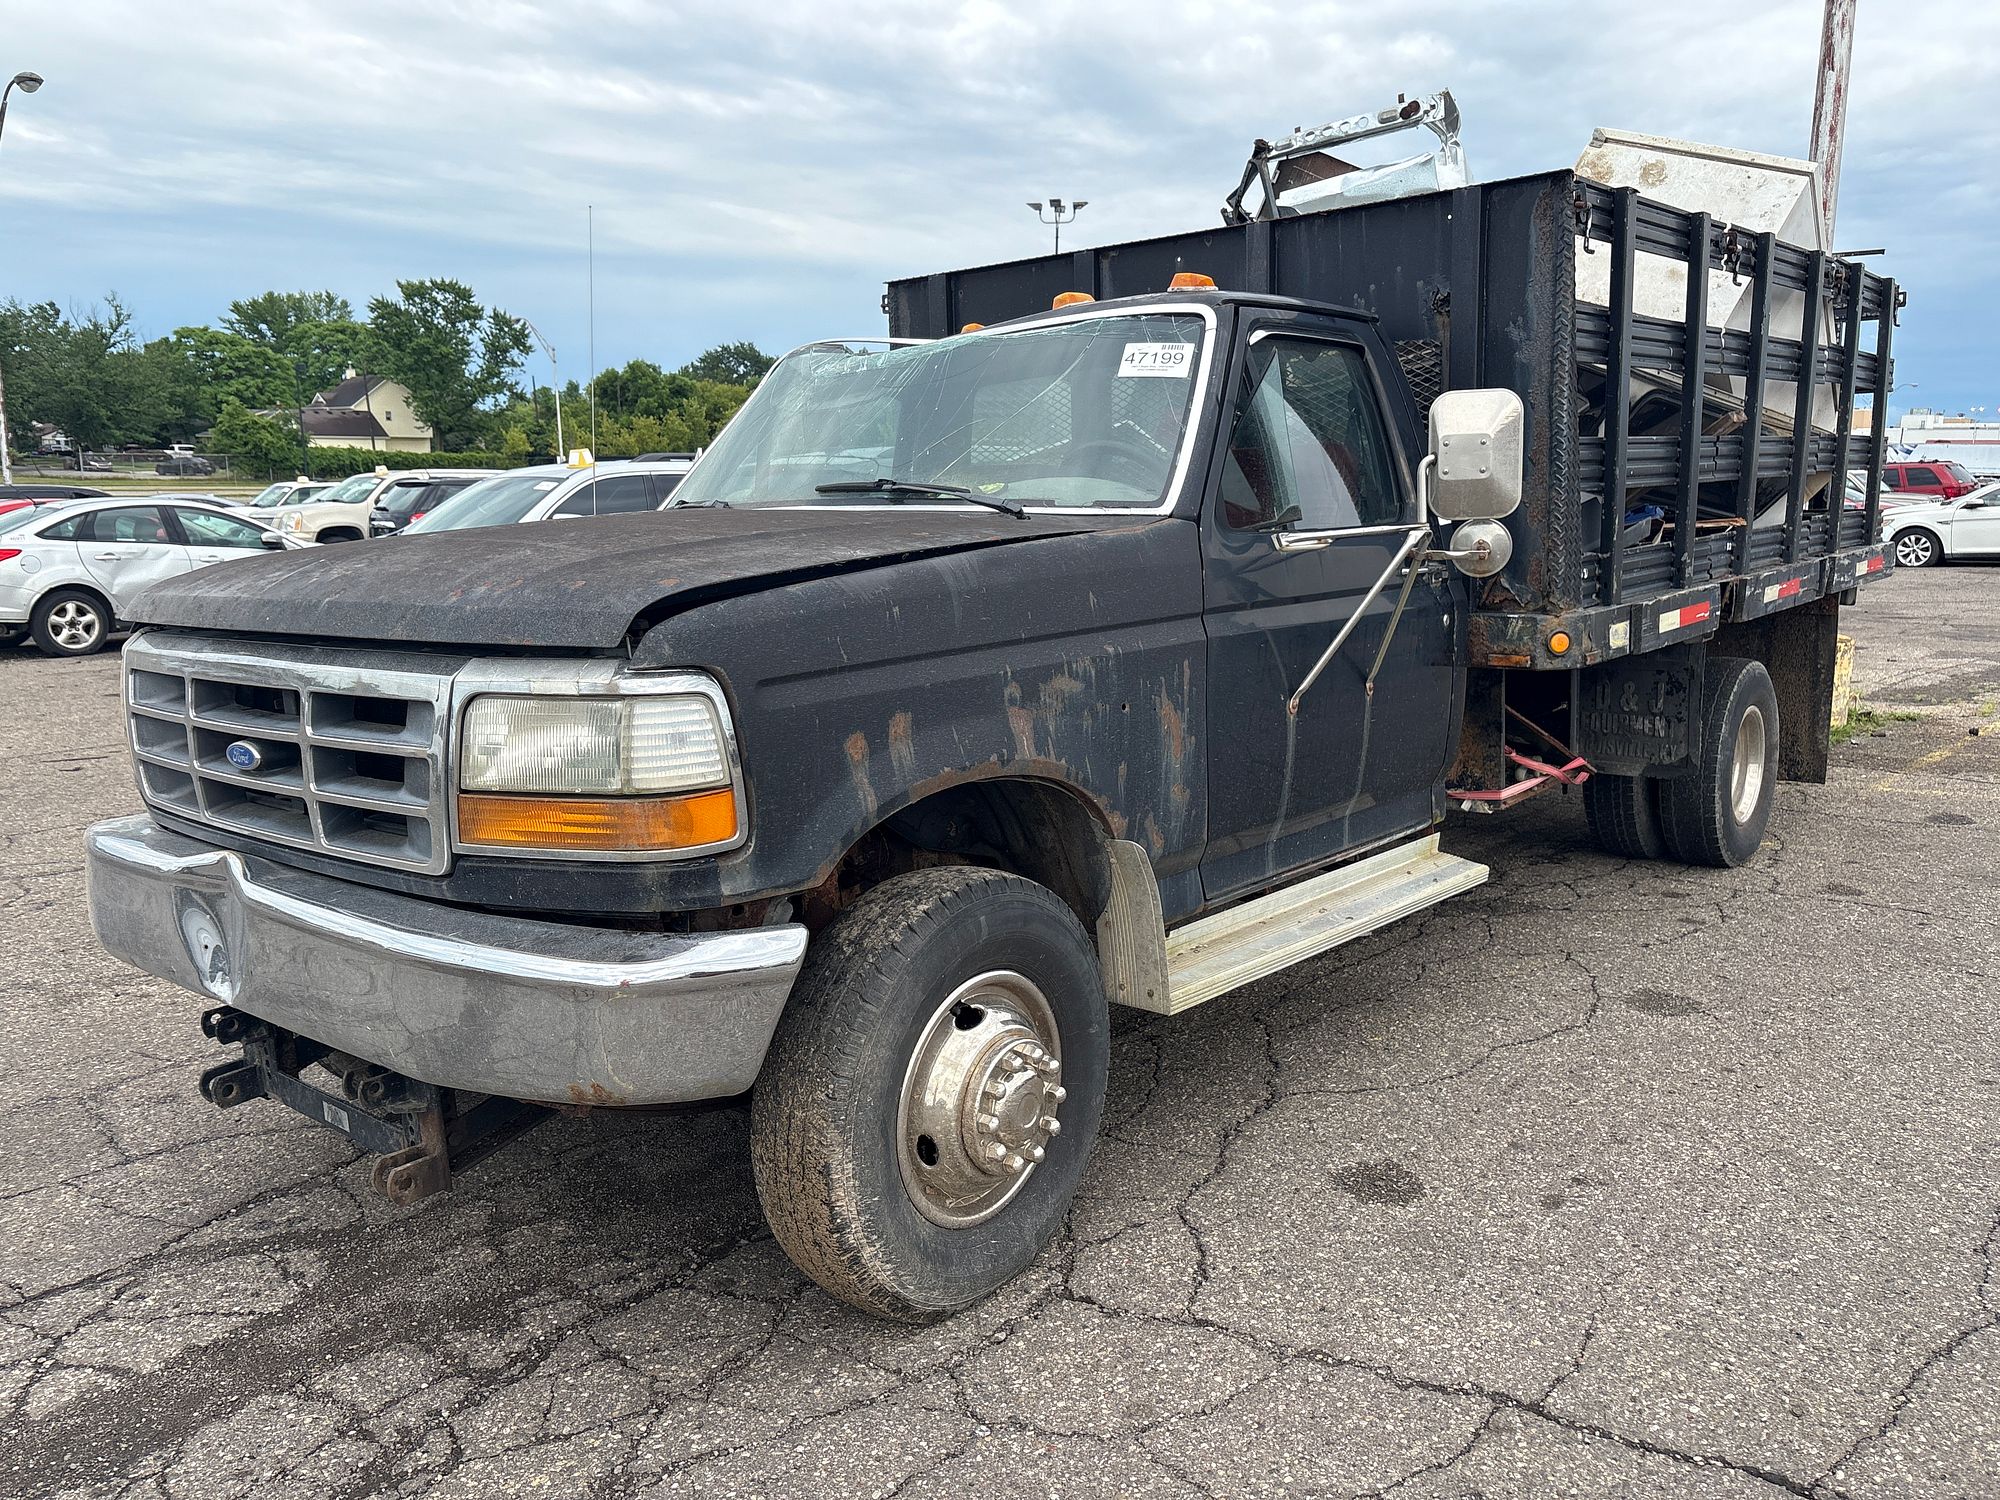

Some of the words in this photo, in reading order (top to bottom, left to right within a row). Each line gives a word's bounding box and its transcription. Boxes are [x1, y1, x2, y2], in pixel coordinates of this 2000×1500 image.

[1124, 352, 1184, 364] 47199
[1620, 681, 1638, 712] &
[1648, 682, 1665, 713] J
[233, 748, 249, 763] Ford
